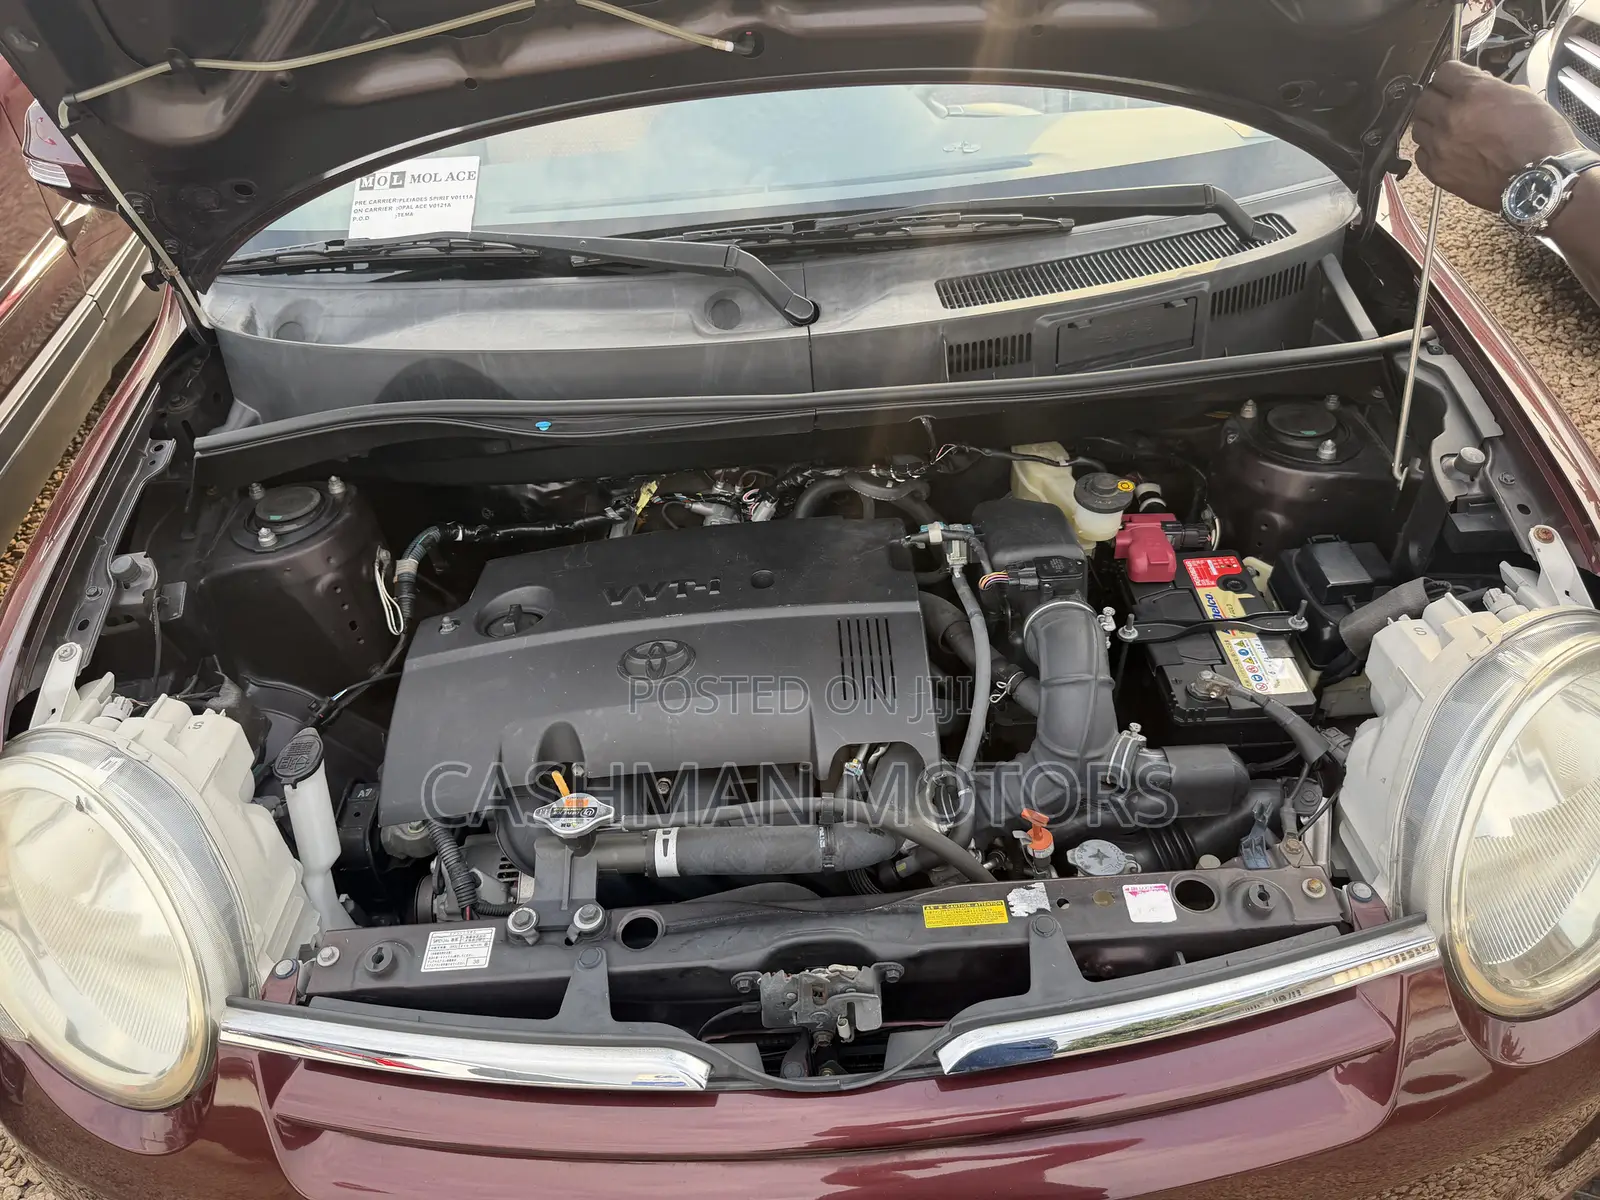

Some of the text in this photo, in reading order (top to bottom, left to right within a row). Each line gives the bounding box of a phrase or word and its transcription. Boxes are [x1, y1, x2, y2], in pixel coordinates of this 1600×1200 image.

[359, 172, 406, 190] MOL
[409, 171, 477, 184] MOL ACE
